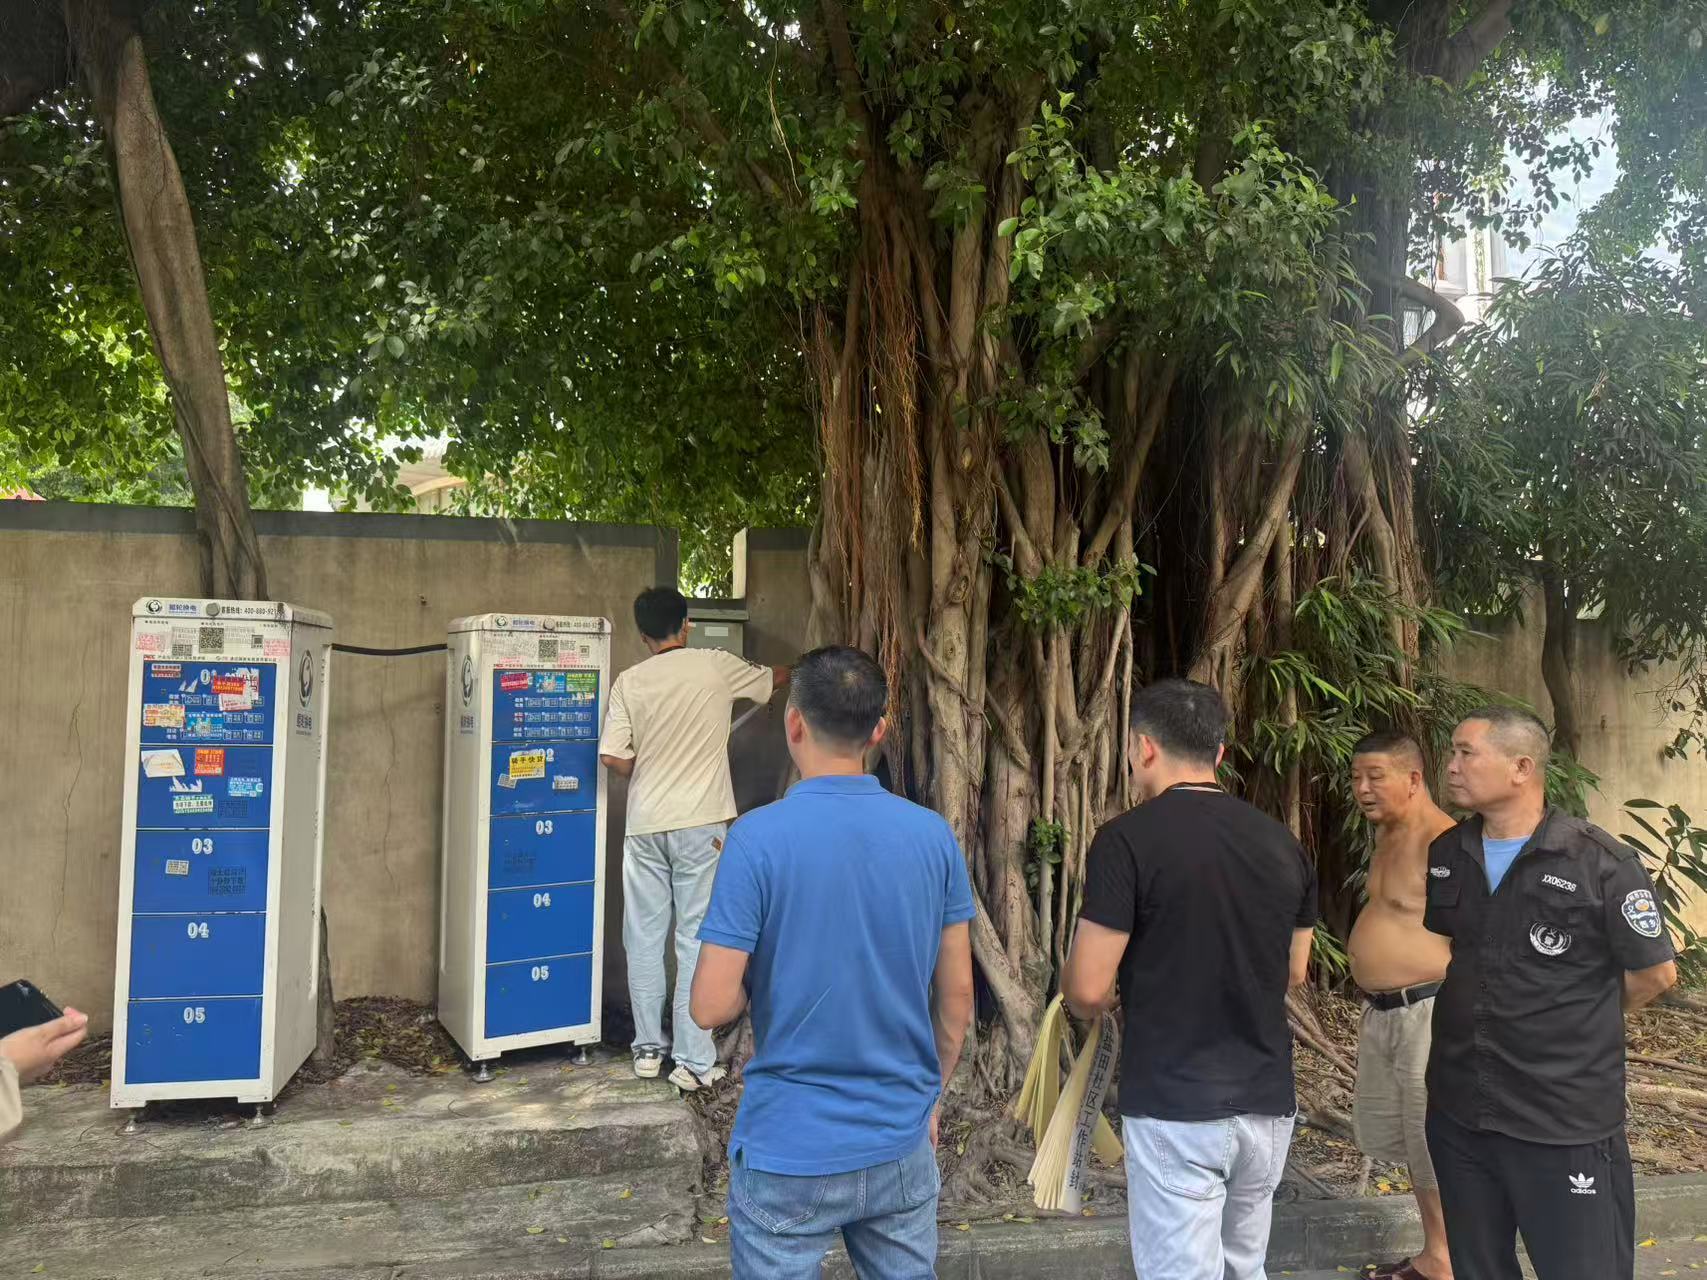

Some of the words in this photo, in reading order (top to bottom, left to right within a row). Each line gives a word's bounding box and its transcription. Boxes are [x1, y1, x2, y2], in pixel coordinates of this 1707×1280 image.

[535, 820, 553, 835] 03
[191, 838, 213, 854] 03
[1541, 873, 1577, 892] XX06238
[533, 893, 551, 908] 04
[187, 922, 209, 939] 04
[531, 966, 549, 981] 05
[183, 1007, 206, 1024] 05
[1570, 1186, 1597, 1195] adidas
